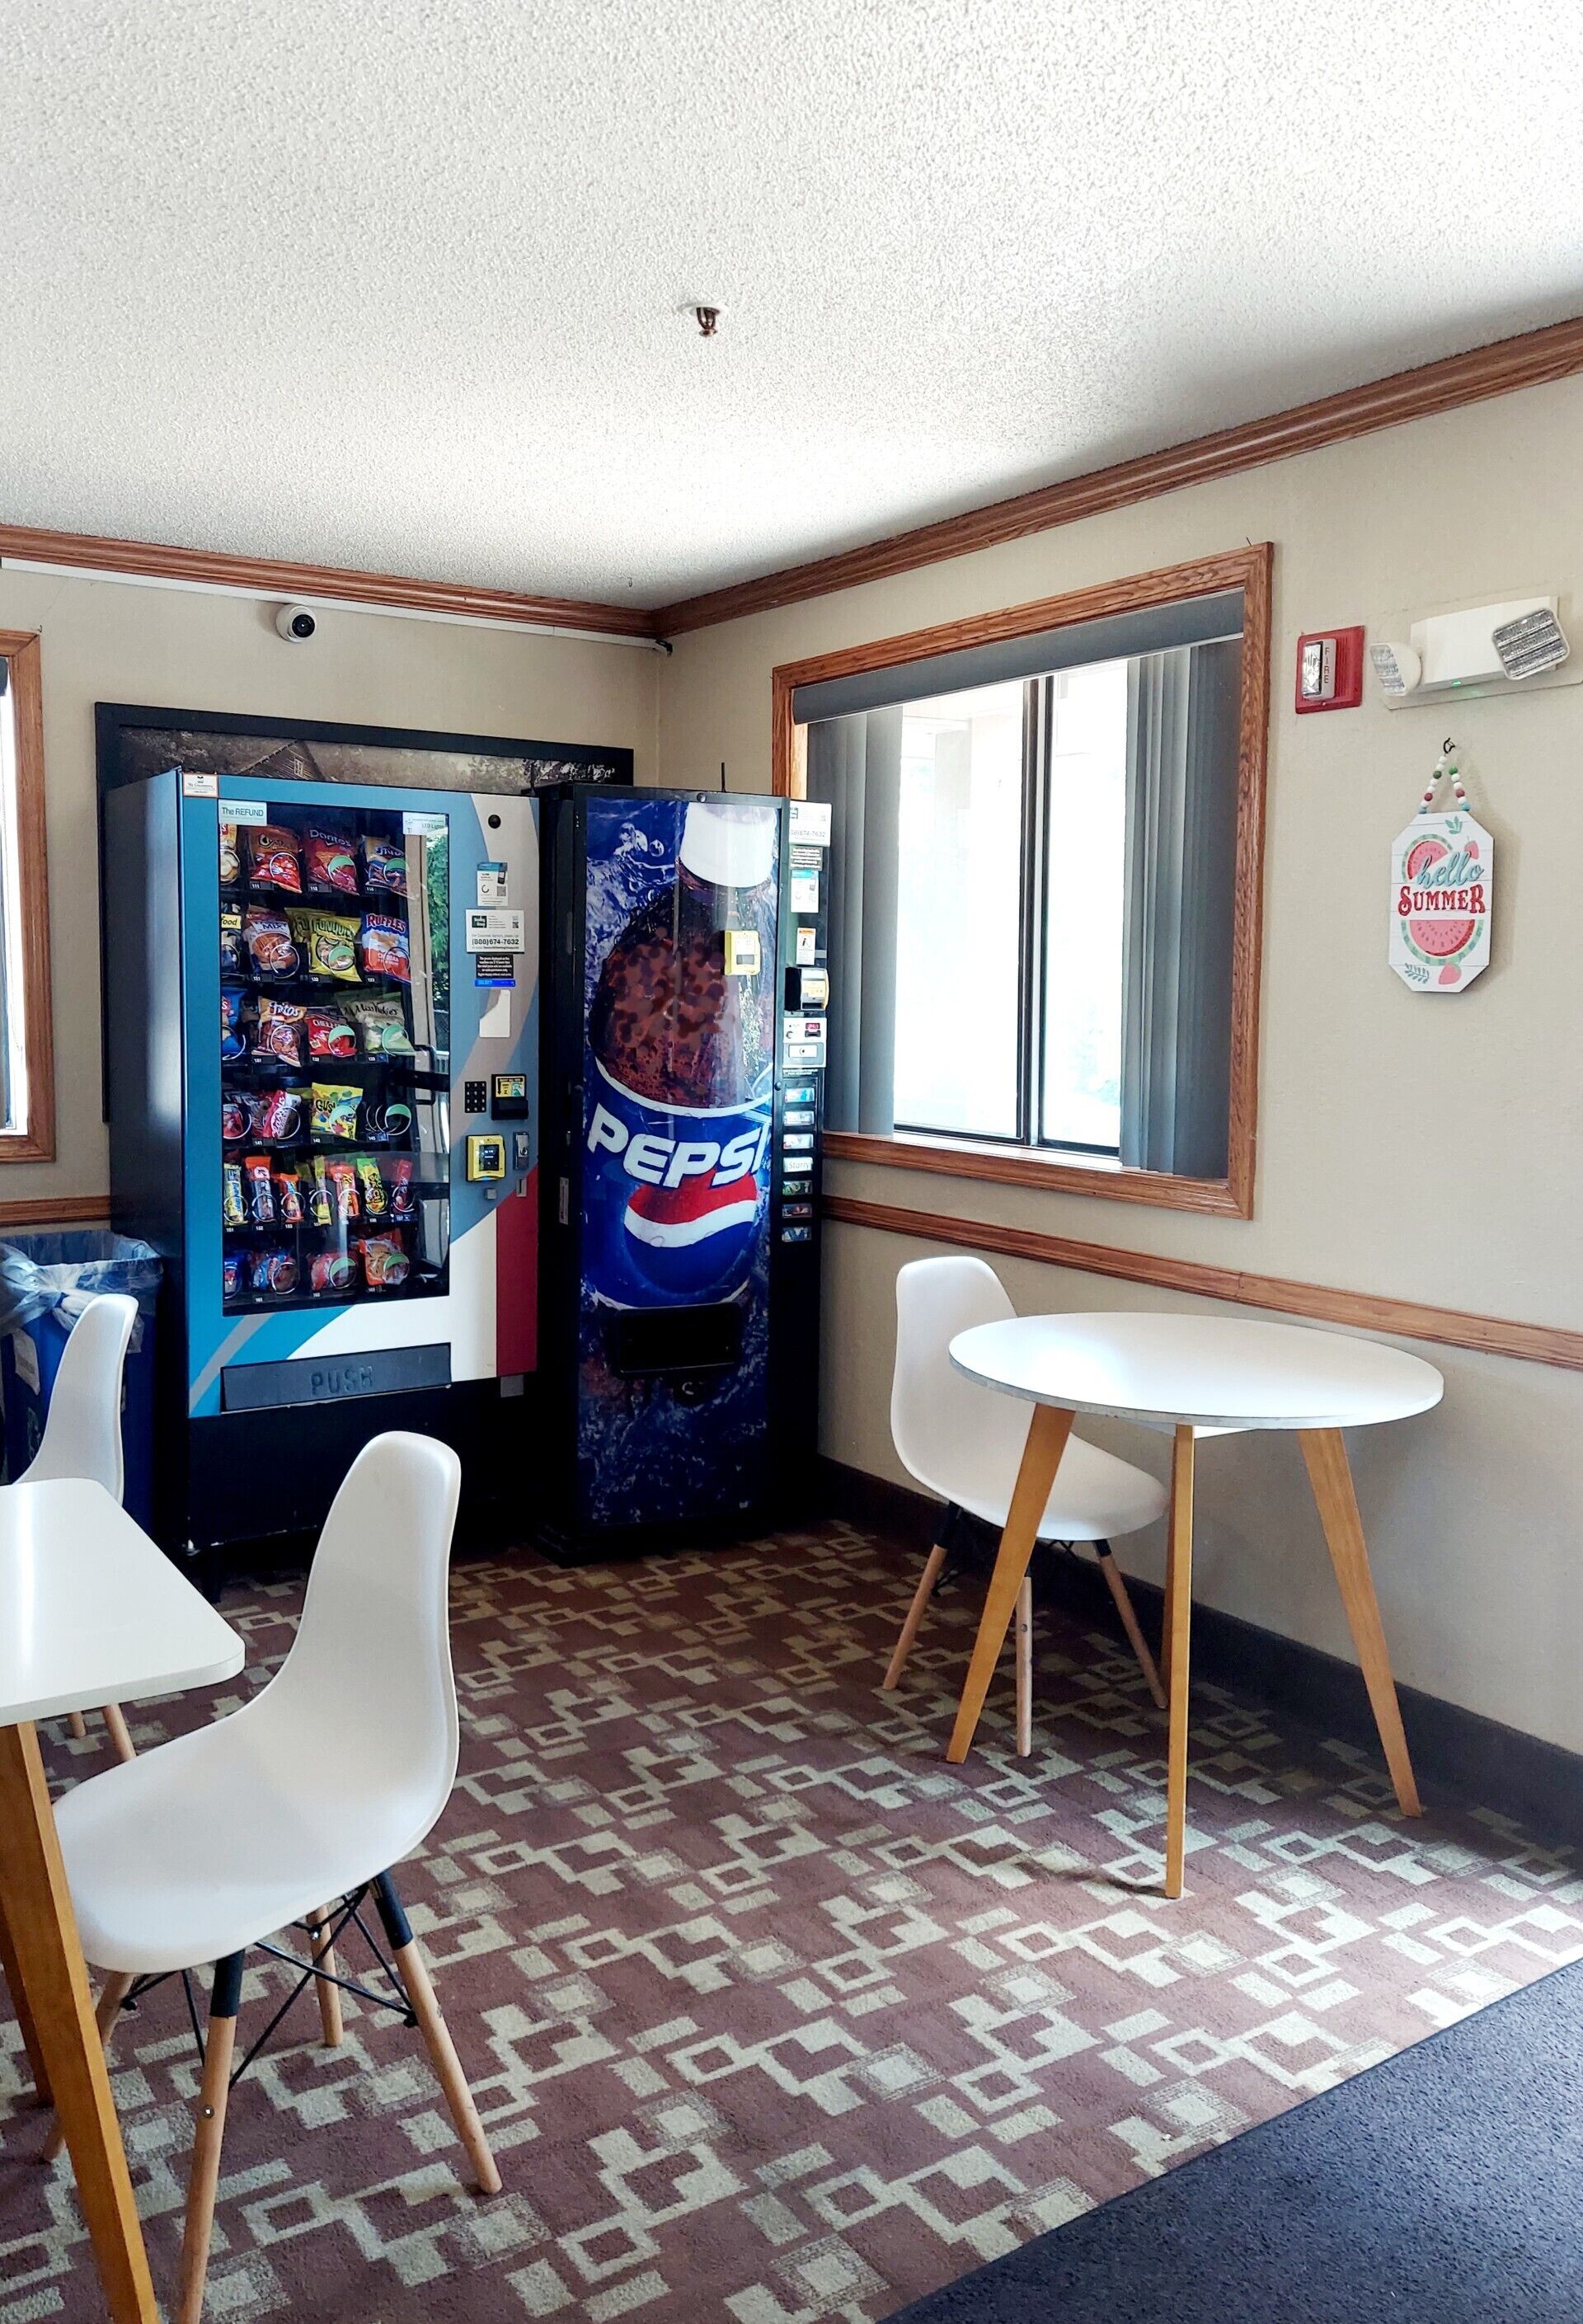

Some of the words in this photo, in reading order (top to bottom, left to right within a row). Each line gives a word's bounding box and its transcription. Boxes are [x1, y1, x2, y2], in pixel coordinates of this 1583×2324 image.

[235, 808, 264, 816] REFUND
[1417, 852, 1484, 889] hello
[1398, 884, 1486, 917] SUMMER
[366, 913, 406, 933] RUFFLES
[269, 1001, 299, 1016] Fritos
[587, 1103, 770, 1188] PEPSI
[310, 1365, 373, 1396] PUSH
